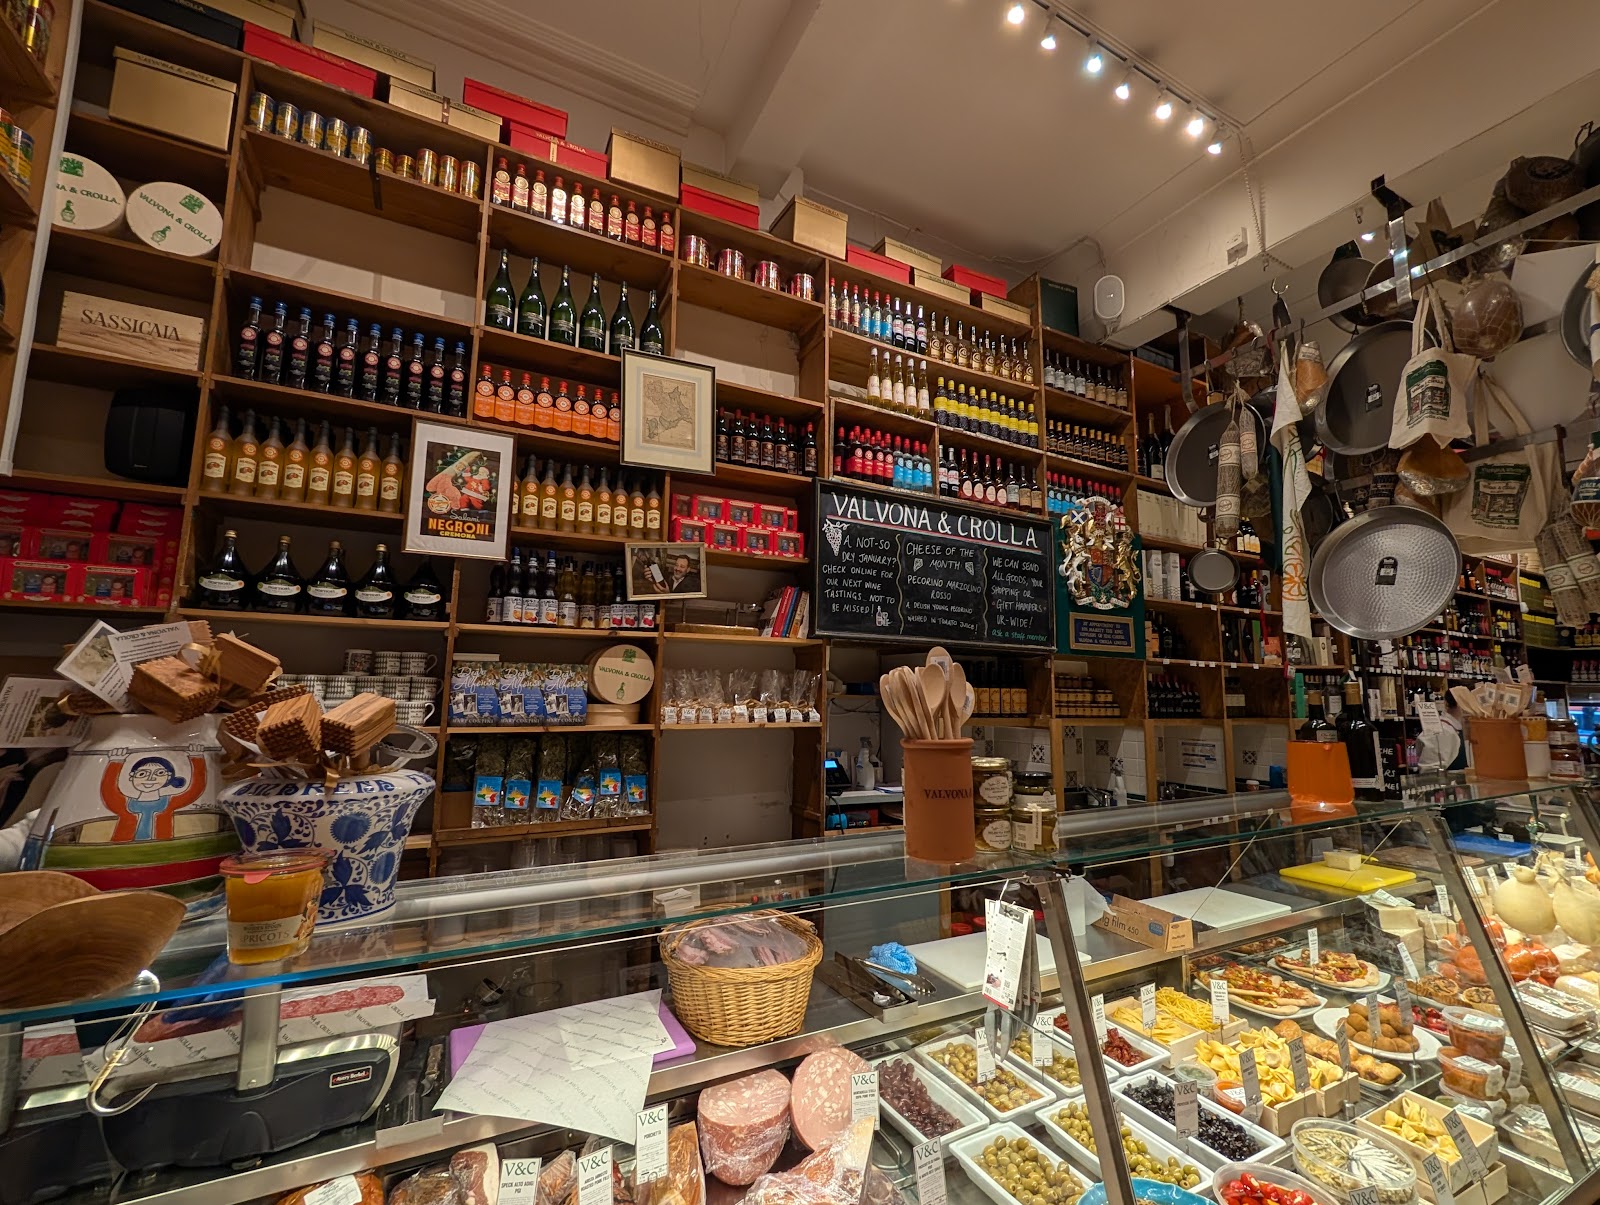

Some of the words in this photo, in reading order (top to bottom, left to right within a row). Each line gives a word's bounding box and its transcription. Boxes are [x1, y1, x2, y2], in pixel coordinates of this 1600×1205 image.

[69, 186, 77, 194] &
[139, 191, 175, 219] VALVONA
[175, 217, 183, 225] &
[80, 309, 181, 341] SASSICAIA
[428, 518, 489, 536] NEGRONI
[831, 492, 932, 531] VALVONA
[938, 511, 951, 534] &
[958, 514, 1038, 548] CROLLA
[439, 530, 476, 539] CREMONA
[843, 535, 852, 548] A
[856, 537, 890, 550] NOT-SO
[906, 542, 942, 556] CHEESE
[945, 547, 957, 556] OF
[960, 548, 975, 558] THE
[842, 551, 855, 563] DRY
[859, 553, 897, 567] JANUARY?
[929, 559, 961, 570] MONTH
[992, 557, 1003, 568] WE
[1004, 558, 1019, 569] CAN
[1022, 562, 1039, 572] SEND
[822, 564, 846, 574] CHECK
[851, 567, 877, 576] ONLINE
[881, 570, 893, 579] FOR
[992, 570, 1004, 580] ALL
[1031, 578, 1043, 588] YOUR
[826, 578, 839, 586] OUR
[842, 579, 862, 587] NEXT
[865, 581, 882, 591] WINE
[907, 575, 944, 587] PECORINO
[946, 580, 982, 593] MARZOLINO
[886, 596, 895, 604] TO
[930, 590, 952, 600] ROSSO
[991, 585, 1020, 600] SHOPPING
[1023, 590, 1034, 598] OR
[832, 603, 840, 612] BE
[906, 601, 911, 609] A
[950, 605, 973, 614] PECORINO
[996, 599, 1014, 612] GIFT
[1016, 602, 1042, 612] HAMPERS
[938, 618, 957, 626] TOMATO
[992, 629, 1003, 637] ask
[1011, 631, 1026, 640] staff
[1027, 634, 1048, 642] member
[599, 665, 624, 676] VALVONA
[1418, 702, 1435, 710] V&C
[925, 788, 969, 800] VALVONA
[1111, 915, 1126, 931] film
[1127, 925, 1140, 936] 450
[853, 1074, 875, 1086] V&C
[1176, 1083, 1195, 1095] V&C
[638, 1108, 665, 1127] V&C
[916, 1141, 939, 1160] V&C
[505, 1161, 536, 1176] V&C
[580, 1151, 608, 1173] V&C
[1352, 1189, 1376, 1205] V&C
